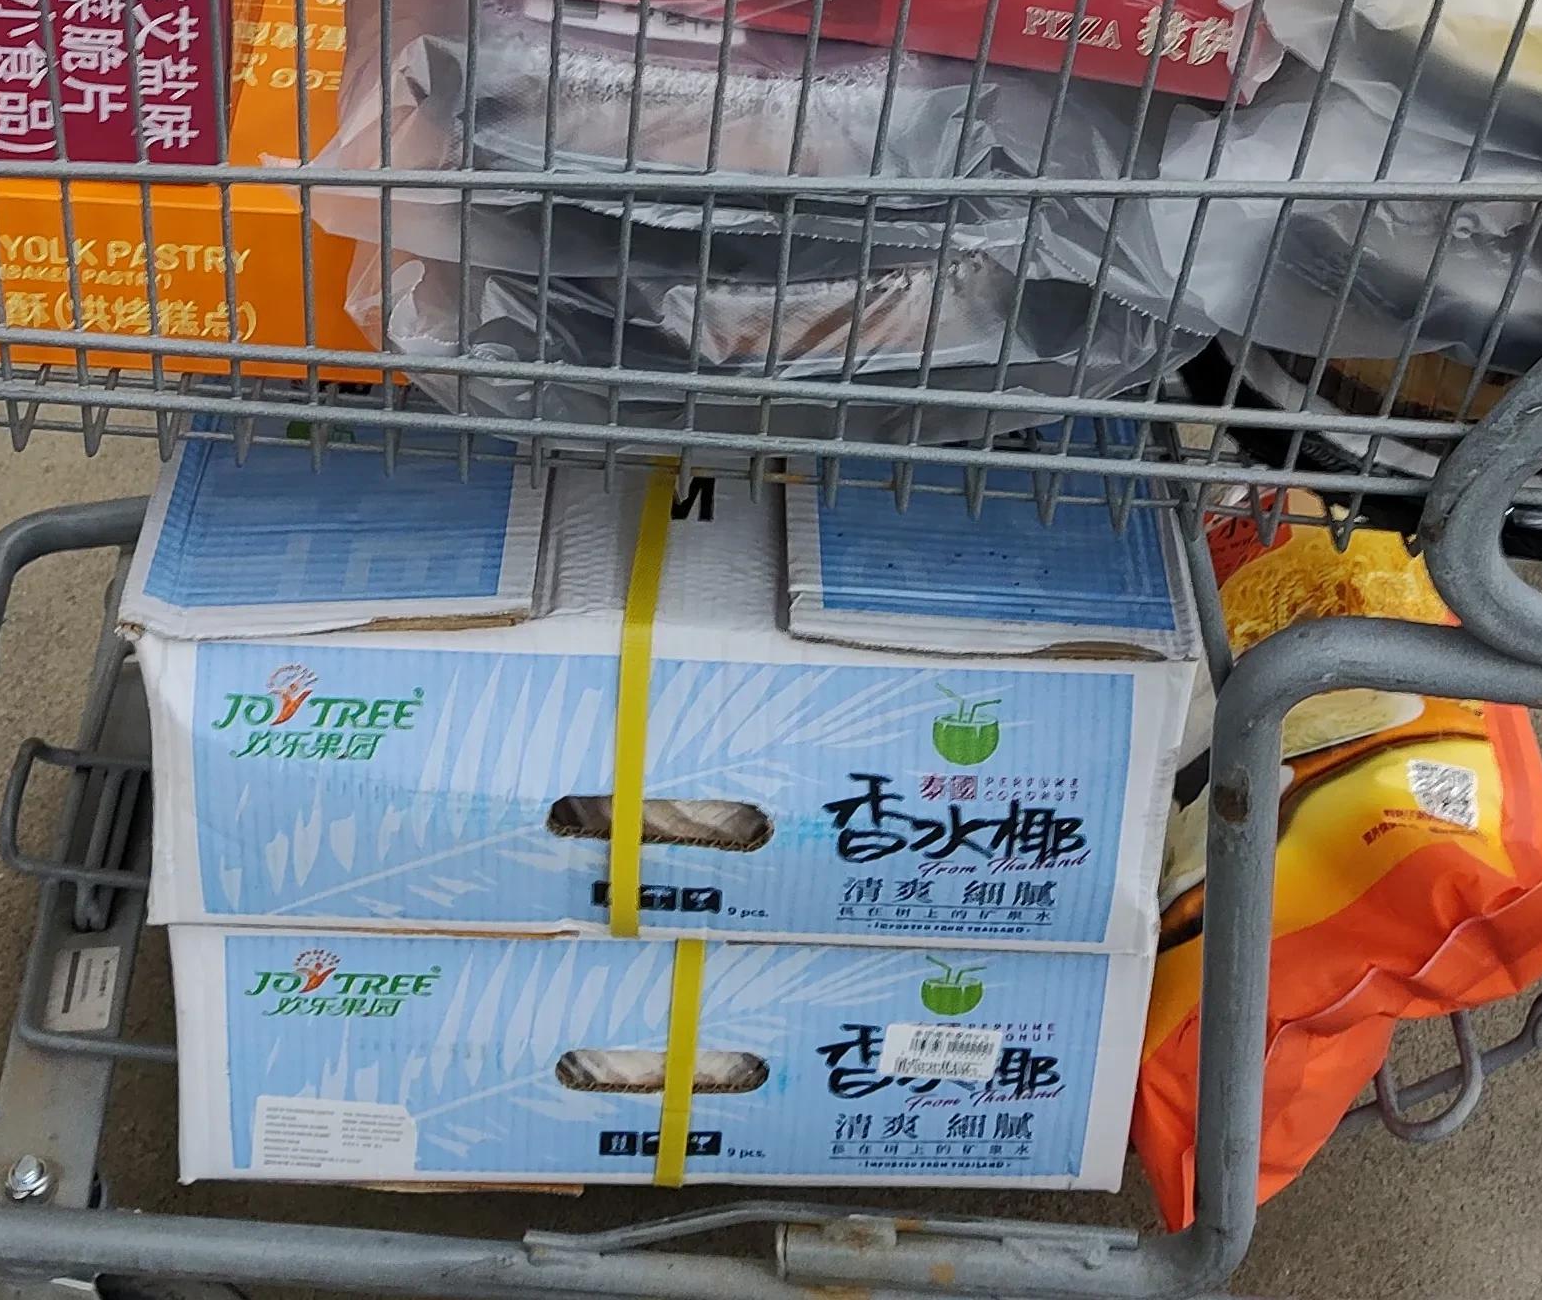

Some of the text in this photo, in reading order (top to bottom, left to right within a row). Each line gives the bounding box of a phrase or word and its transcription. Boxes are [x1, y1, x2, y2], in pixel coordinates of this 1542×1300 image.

[1021, 5, 1123, 60] PIZZA
[105, 239, 252, 276] PASTRY
[211, 688, 425, 731] JOY TREE
[228, 729, 386, 762] 欢乐果园
[822, 771, 1087, 864] 香水椰
[917, 859, 978, 878] From
[842, 876, 936, 904] 清爽
[727, 906, 738, 918] 9
[244, 966, 442, 997] JOY TREE
[816, 1022, 1061, 1100] 香椰
[905, 1093, 962, 1111] From
[834, 1112, 920, 1140] 清爽
[727, 1146, 737, 1158] 9
